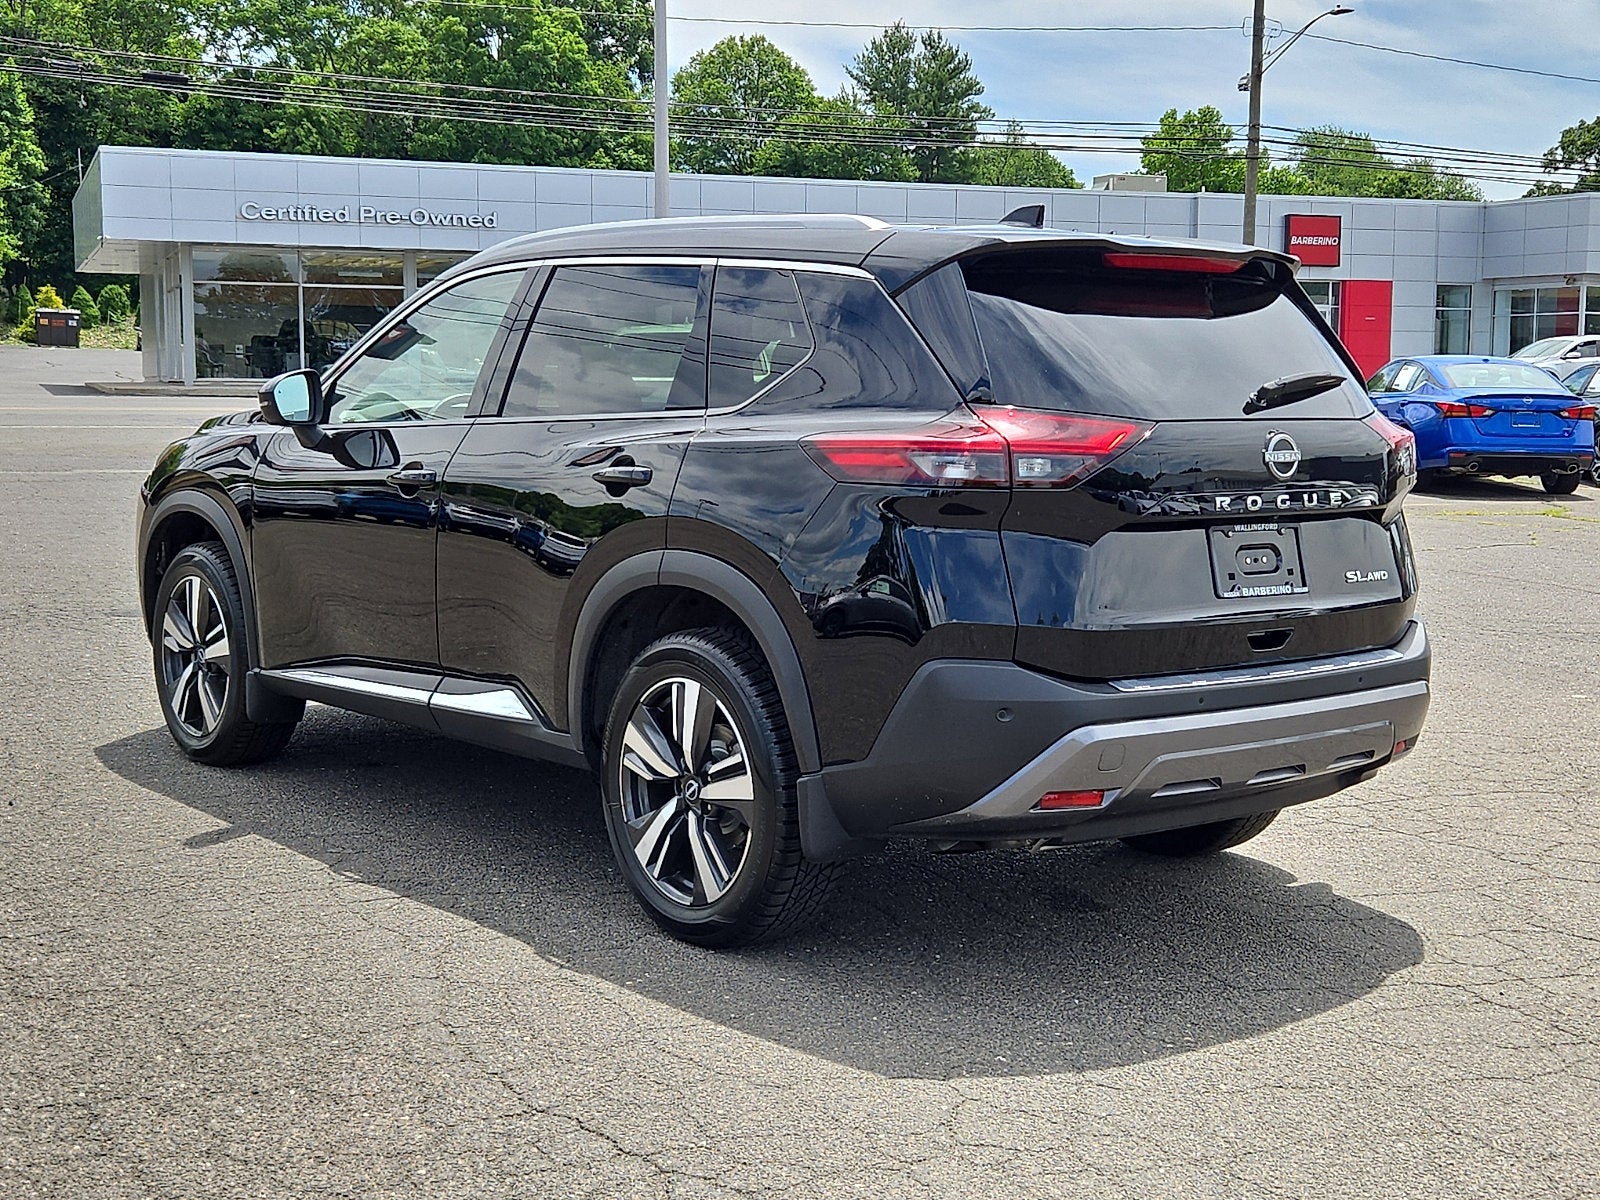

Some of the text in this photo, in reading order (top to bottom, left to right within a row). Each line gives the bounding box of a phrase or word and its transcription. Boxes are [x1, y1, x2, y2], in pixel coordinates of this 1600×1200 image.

[240, 201, 498, 228] Certified Pre-Owned
[1290, 235, 1339, 246] BARBERINO
[1265, 451, 1301, 462] NISSAN
[1214, 492, 1343, 512] ROGUE
[1233, 523, 1279, 532] WALLINGFORD
[1242, 585, 1292, 597] BARBERINO
